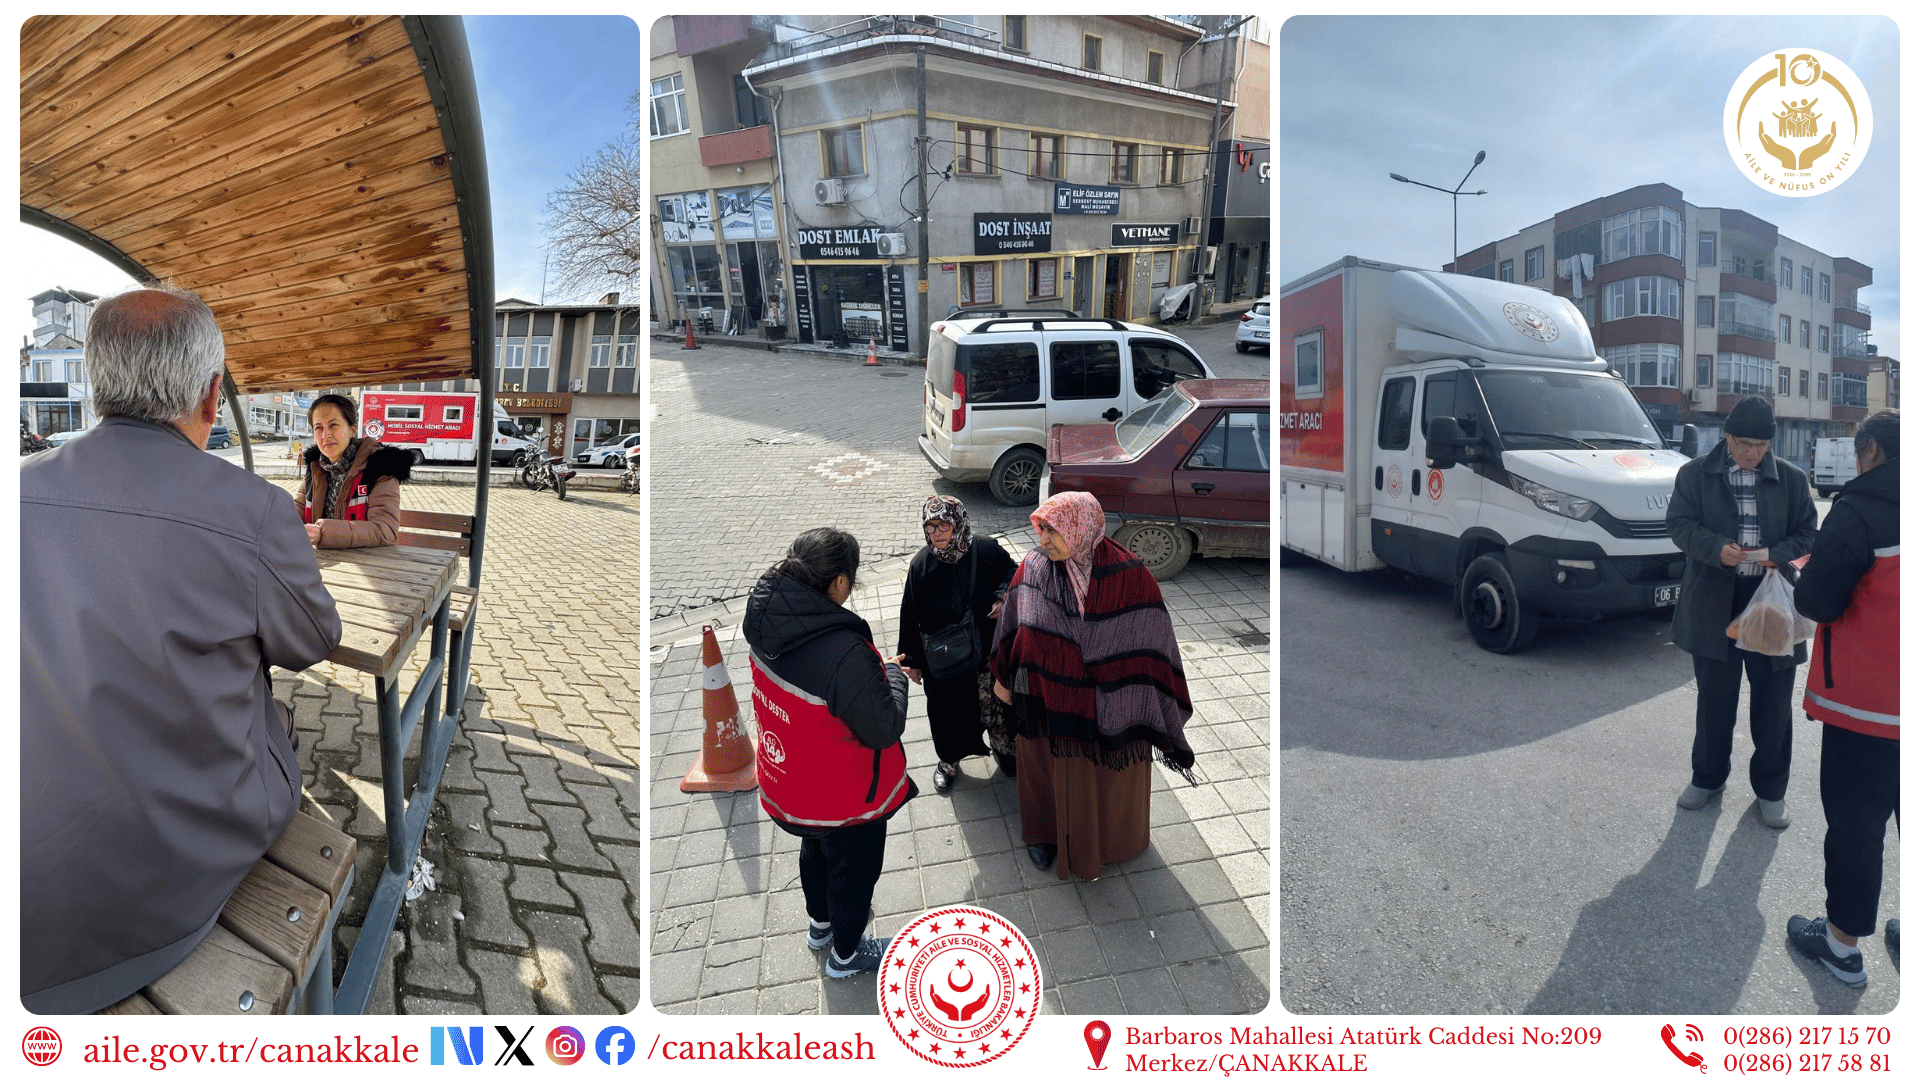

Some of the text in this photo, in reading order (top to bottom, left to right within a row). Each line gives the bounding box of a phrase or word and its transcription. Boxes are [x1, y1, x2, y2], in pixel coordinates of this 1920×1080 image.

[1073, 188, 1085, 197] ELİF
[1085, 189, 1103, 197] ÖZLEM
[799, 228, 880, 245] DOST EMLAK
[979, 217, 1052, 239] DOST İNŞAAT
[1121, 226, 1171, 238] VETHANE
[1300, 412, 1323, 430] ARACI
[1660, 588, 1671, 601] 06
[769, 700, 790, 725] DESTEK
